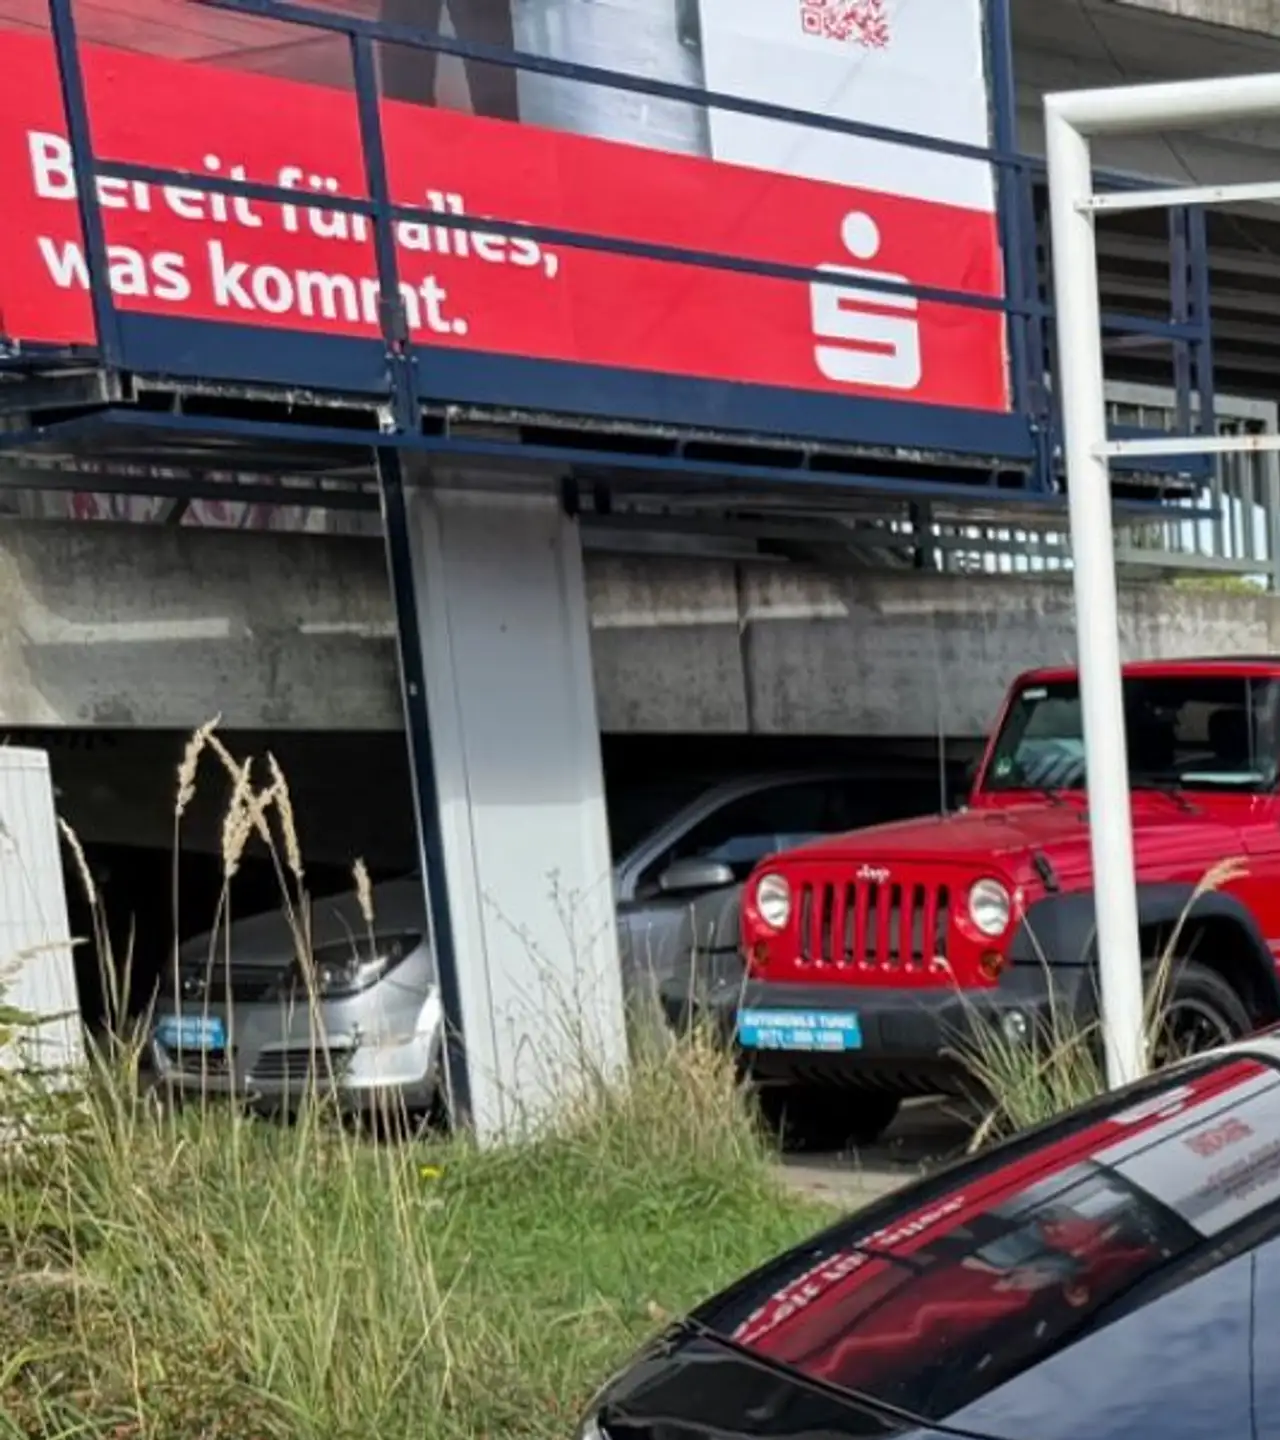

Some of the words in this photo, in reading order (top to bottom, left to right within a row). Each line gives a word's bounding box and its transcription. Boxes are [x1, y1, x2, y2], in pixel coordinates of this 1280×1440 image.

[27, 130, 263, 227] Bereit
[396, 190, 560, 279] alles,
[38, 234, 190, 301] was
[210, 240, 470, 336] kommt.
